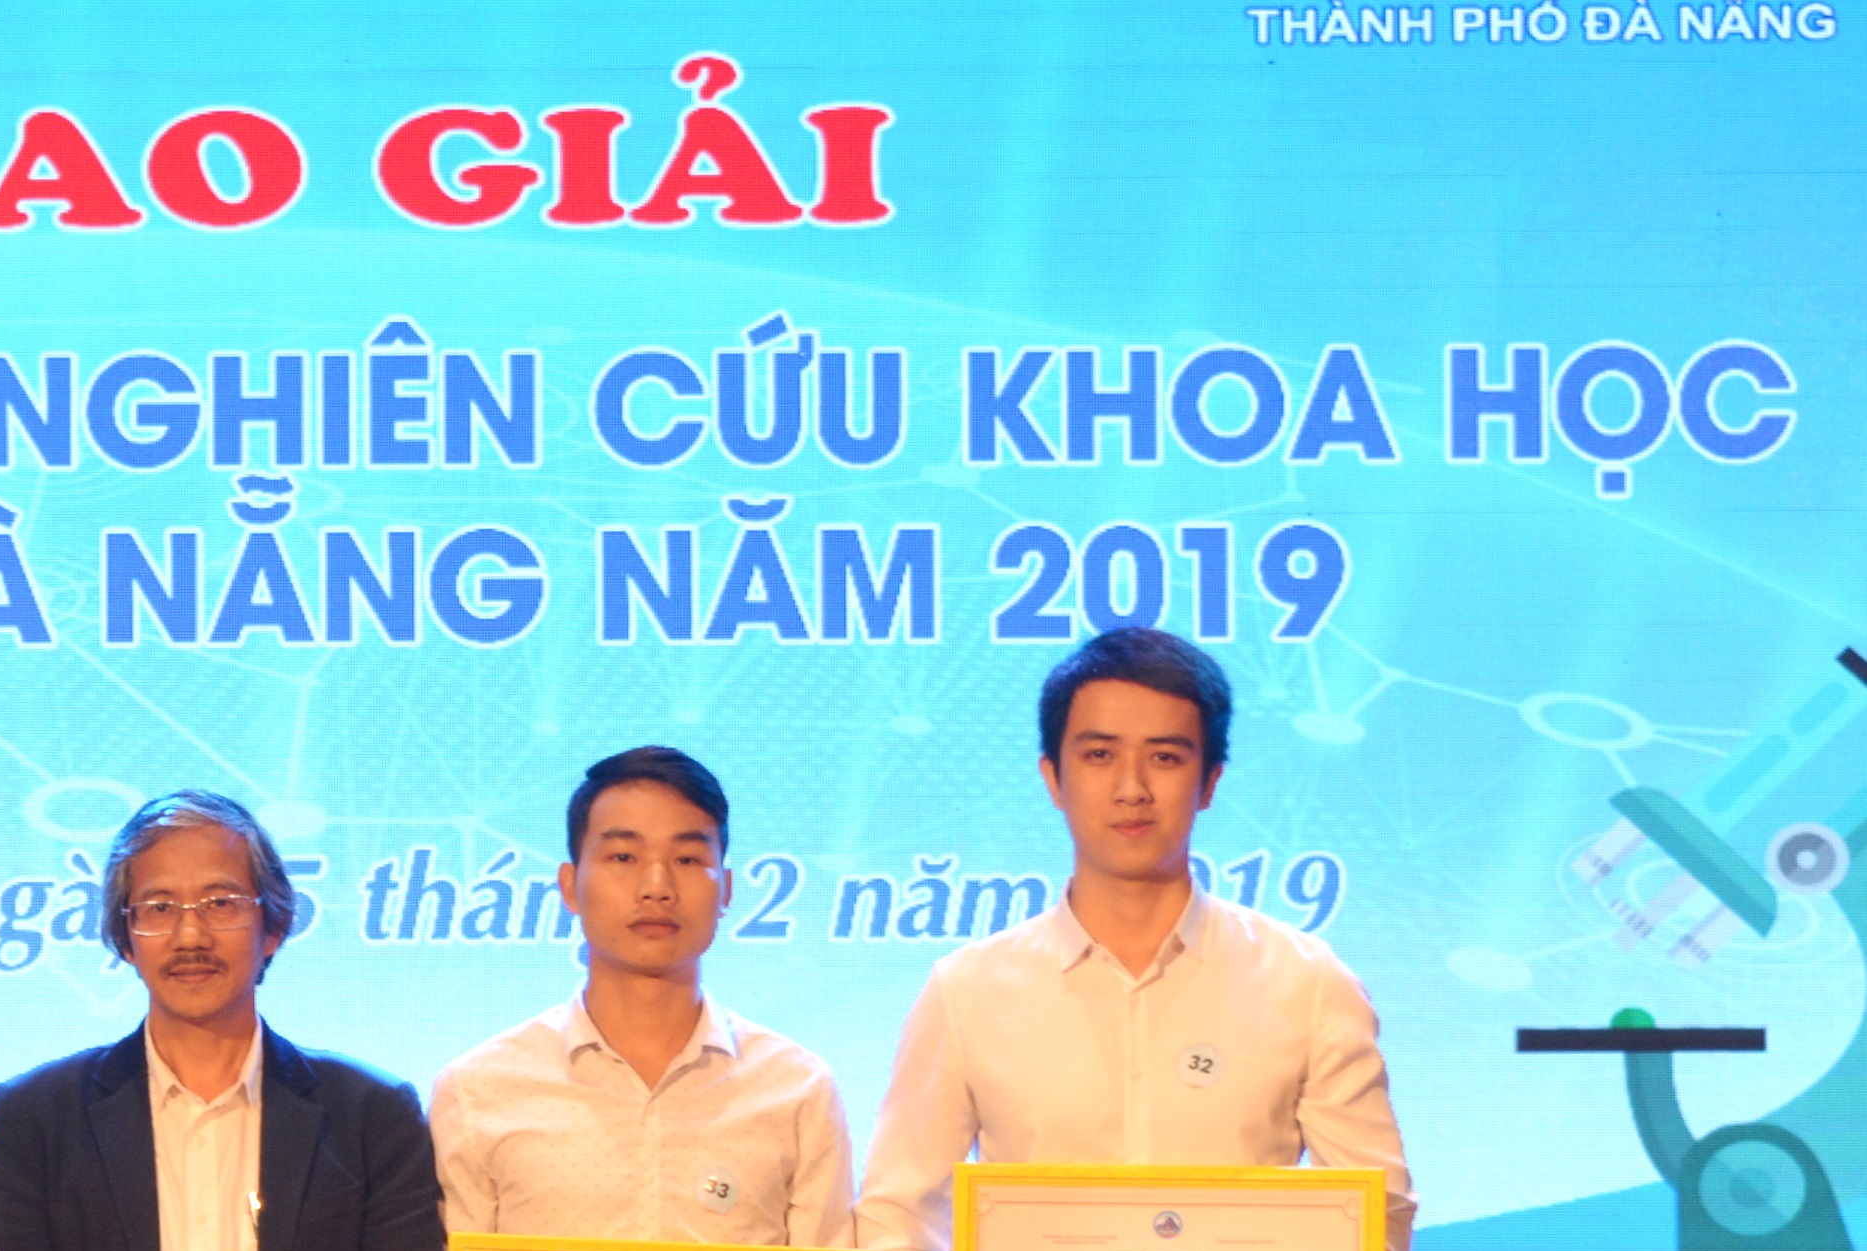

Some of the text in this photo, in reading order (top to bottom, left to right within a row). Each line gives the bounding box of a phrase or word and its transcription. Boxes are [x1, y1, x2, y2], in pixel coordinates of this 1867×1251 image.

[379, 57, 889, 226] GIẢI
[595, 314, 902, 465] CỨU
[968, 347, 1396, 464] KHOA
[1449, 344, 1792, 494] HỌC
[105, 474, 545, 645] NẴNG
[601, 497, 936, 642] NĂM
[994, 524, 1347, 640] 2019
[364, 848, 589, 967] thán
[735, 857, 800, 939] 2
[833, 857, 1047, 939] năm
[1188, 1055, 1214, 1074] 32
